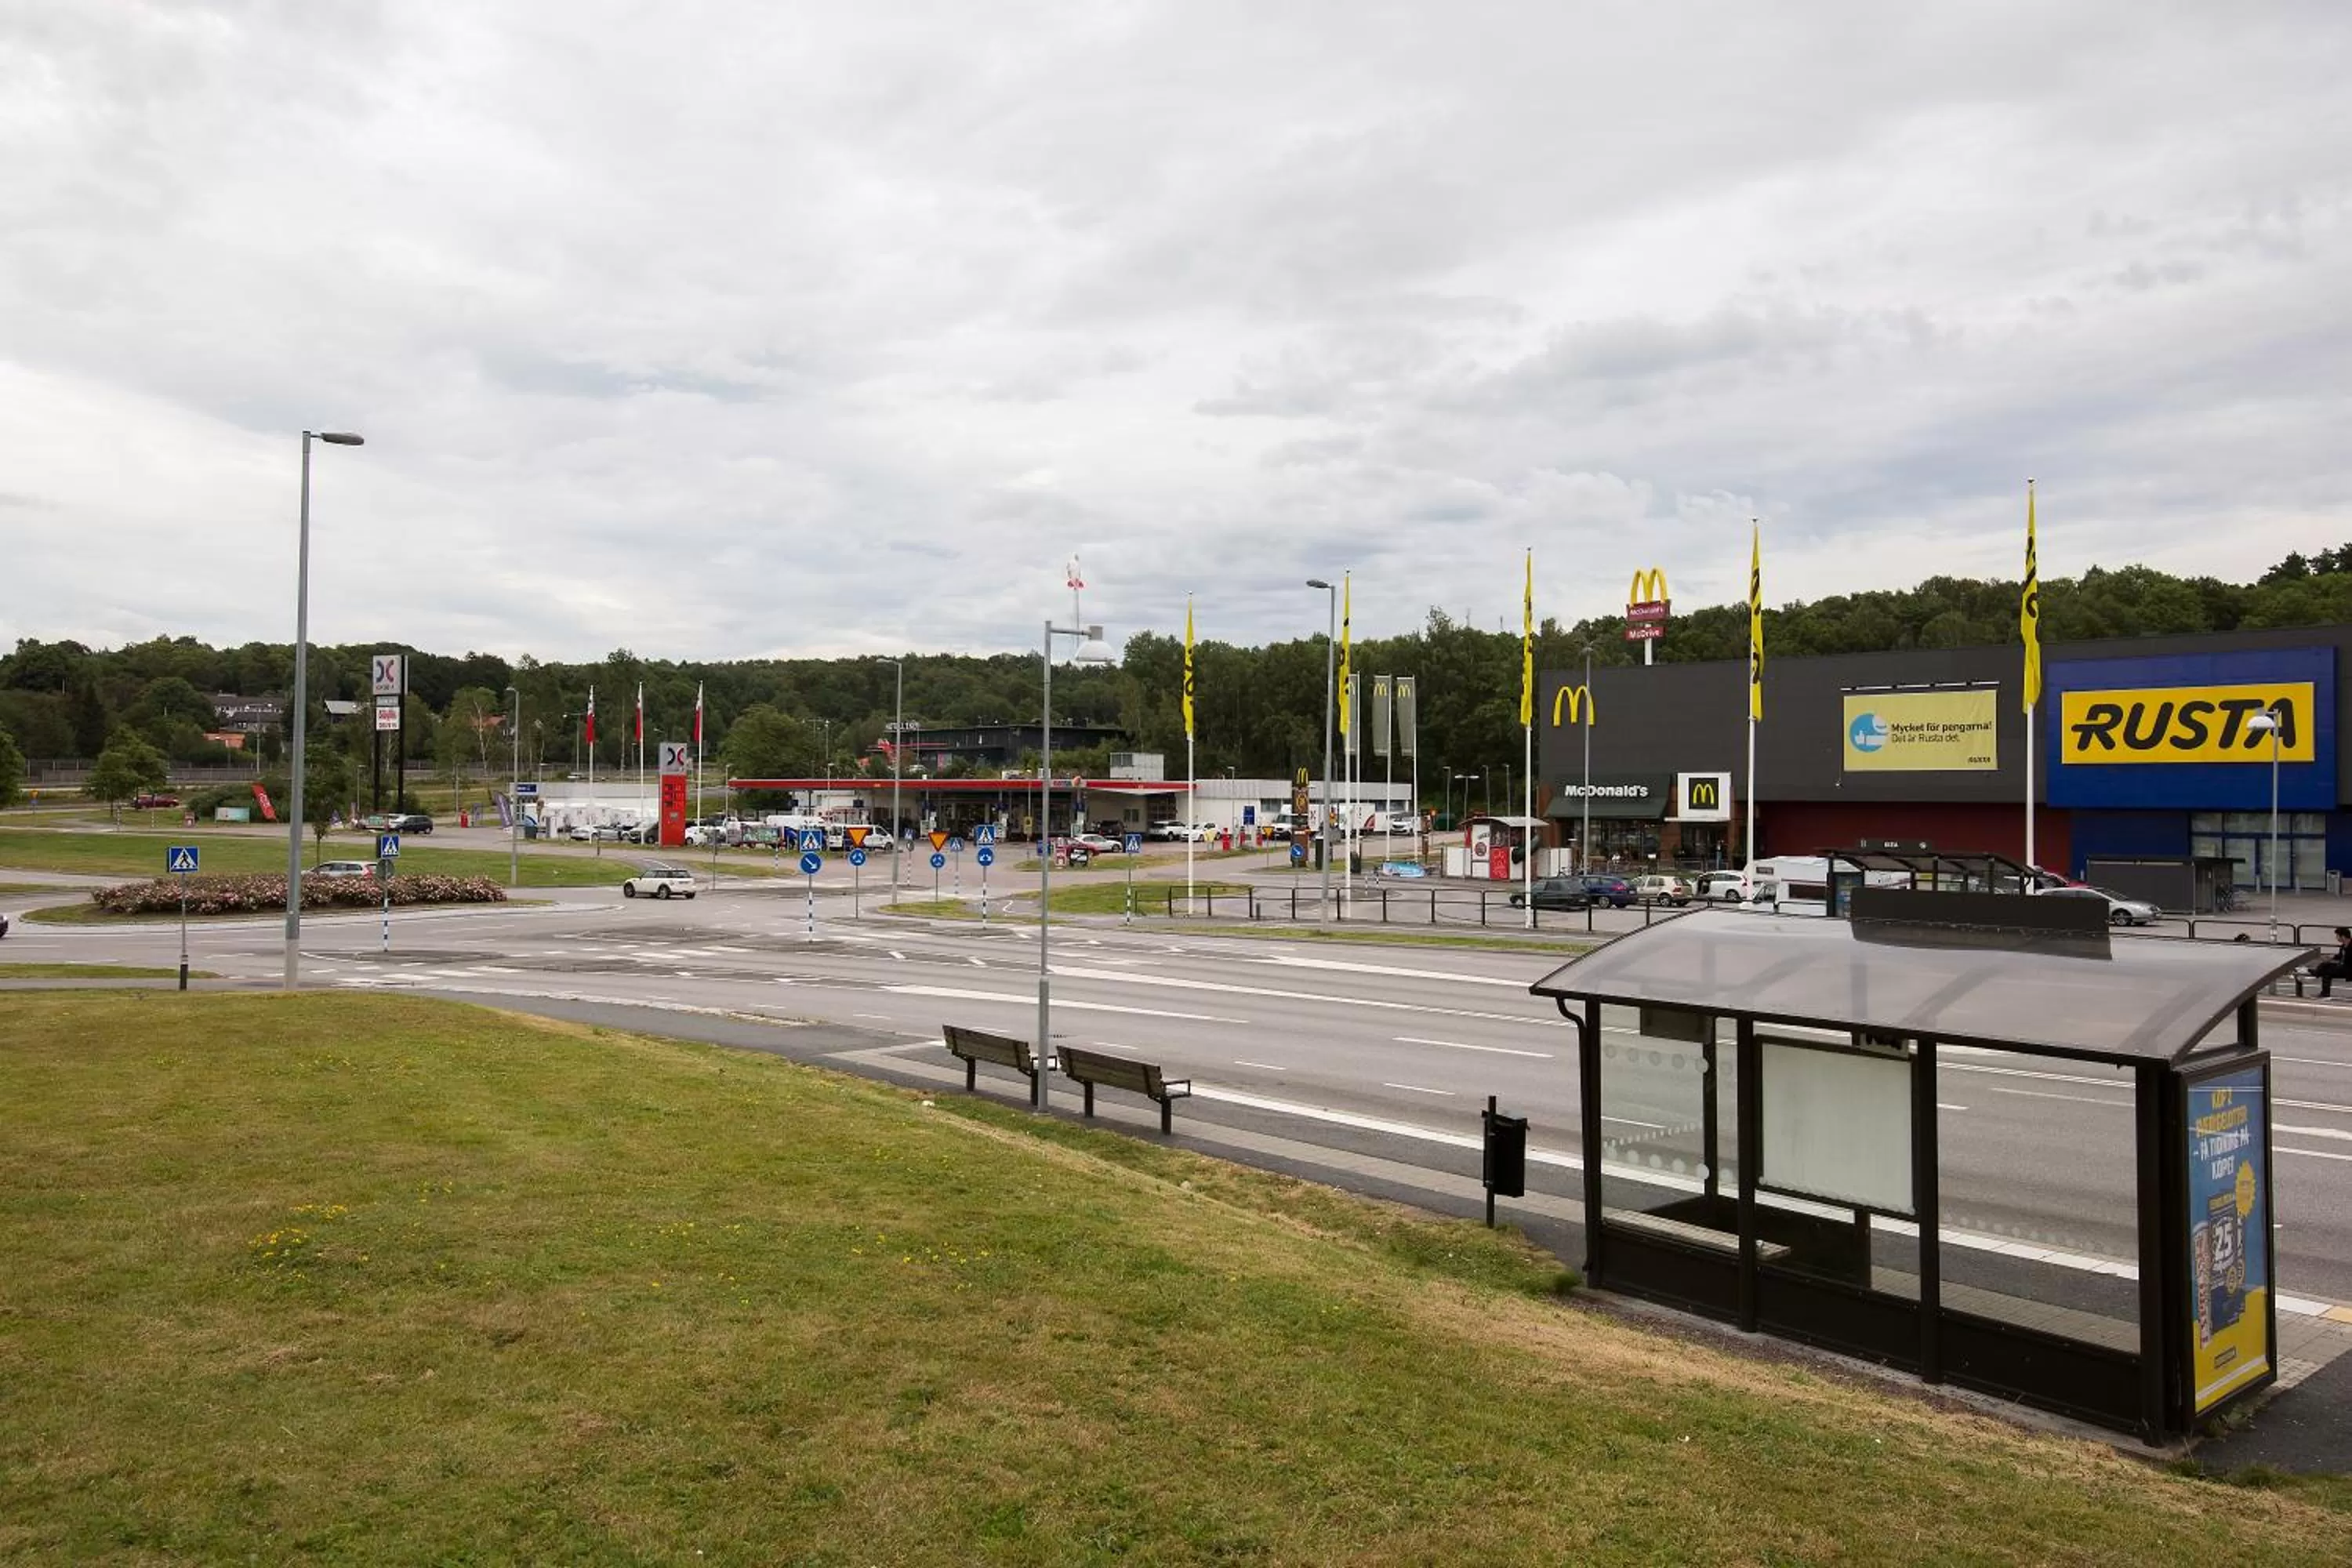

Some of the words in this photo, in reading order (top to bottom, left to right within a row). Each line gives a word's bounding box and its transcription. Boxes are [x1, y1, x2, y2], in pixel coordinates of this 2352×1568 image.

[1630, 629, 1660, 638] McDrive
[1891, 722, 1925, 734] Mycket
[1926, 722, 1940, 731] för
[1942, 721, 1992, 733] pengarna!
[2071, 697, 2296, 750] RUSTA
[1891, 734, 1906, 743] Det
[1907, 734, 1917, 742] är
[1918, 733, 1944, 742] Rusta
[1565, 785, 1648, 797] McDonald's
